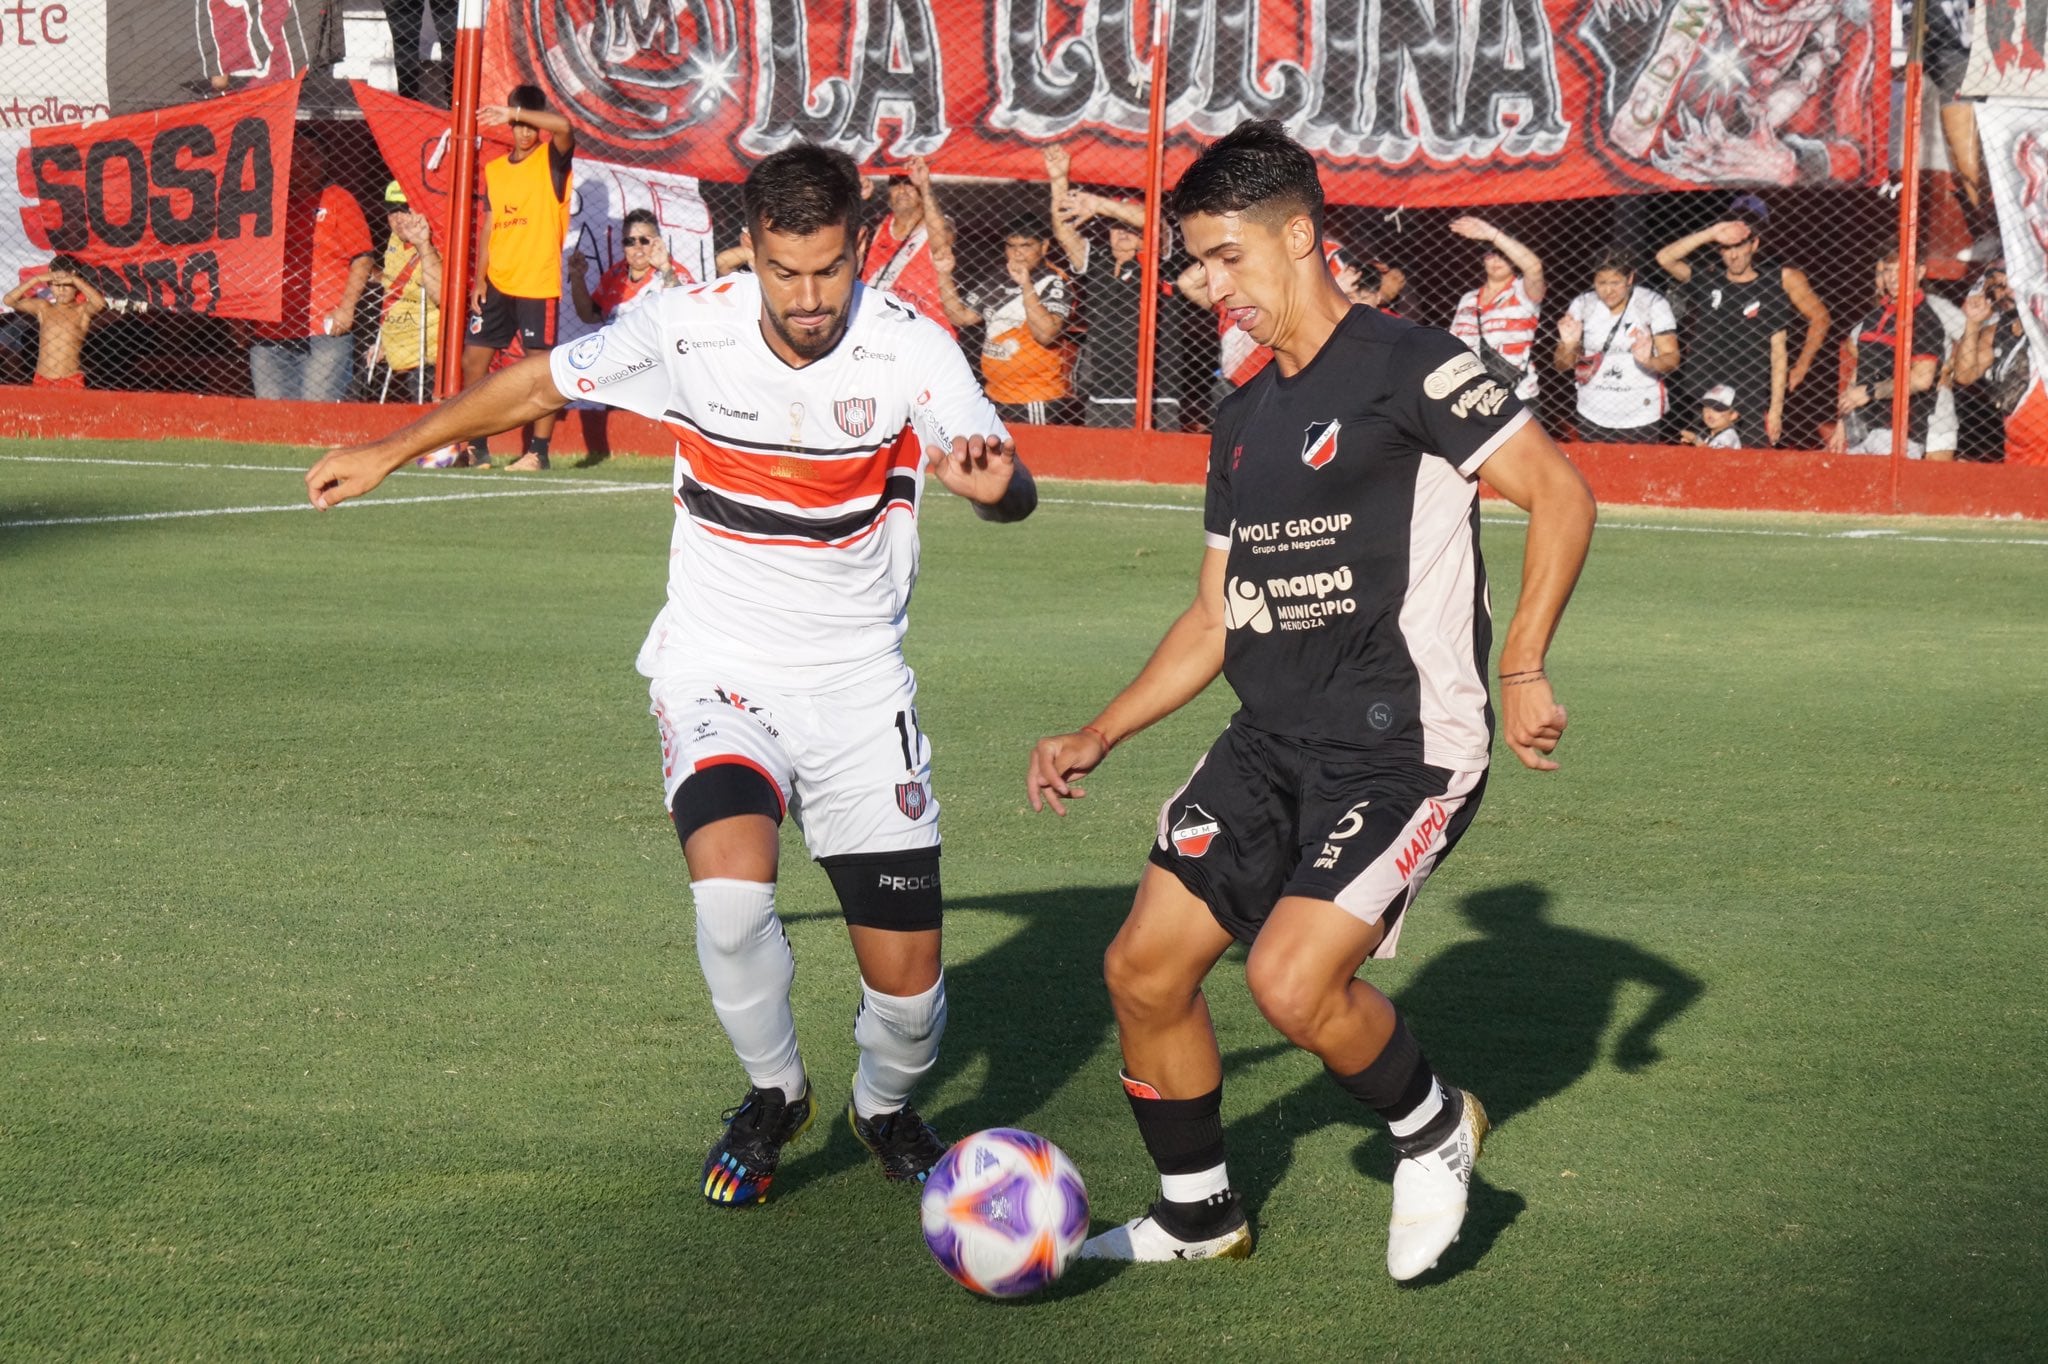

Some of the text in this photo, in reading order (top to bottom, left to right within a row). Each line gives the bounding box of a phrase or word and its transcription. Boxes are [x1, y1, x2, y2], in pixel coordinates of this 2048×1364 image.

[0, 3, 68, 45] te
[738, 0, 952, 164] LA
[31, 117, 273, 251] SOSA
[597, 368, 629, 385] Grupo
[719, 403, 759, 422] hummel
[1238, 513, 1352, 543] WOLF GROUP
[1252, 537, 1336, 555] Grupo de Negocios
[1266, 565, 1353, 599] maipú
[1277, 598, 1356, 620] MUNICIPIO
[1280, 618, 1325, 632] MENDOZA
[895, 708, 921, 771] 11
[1328, 800, 1370, 840] 5
[1395, 800, 1447, 882] MAIPÚ
[1312, 857, 1338, 869] IFK
[1459, 1132, 1473, 1194] adidas
